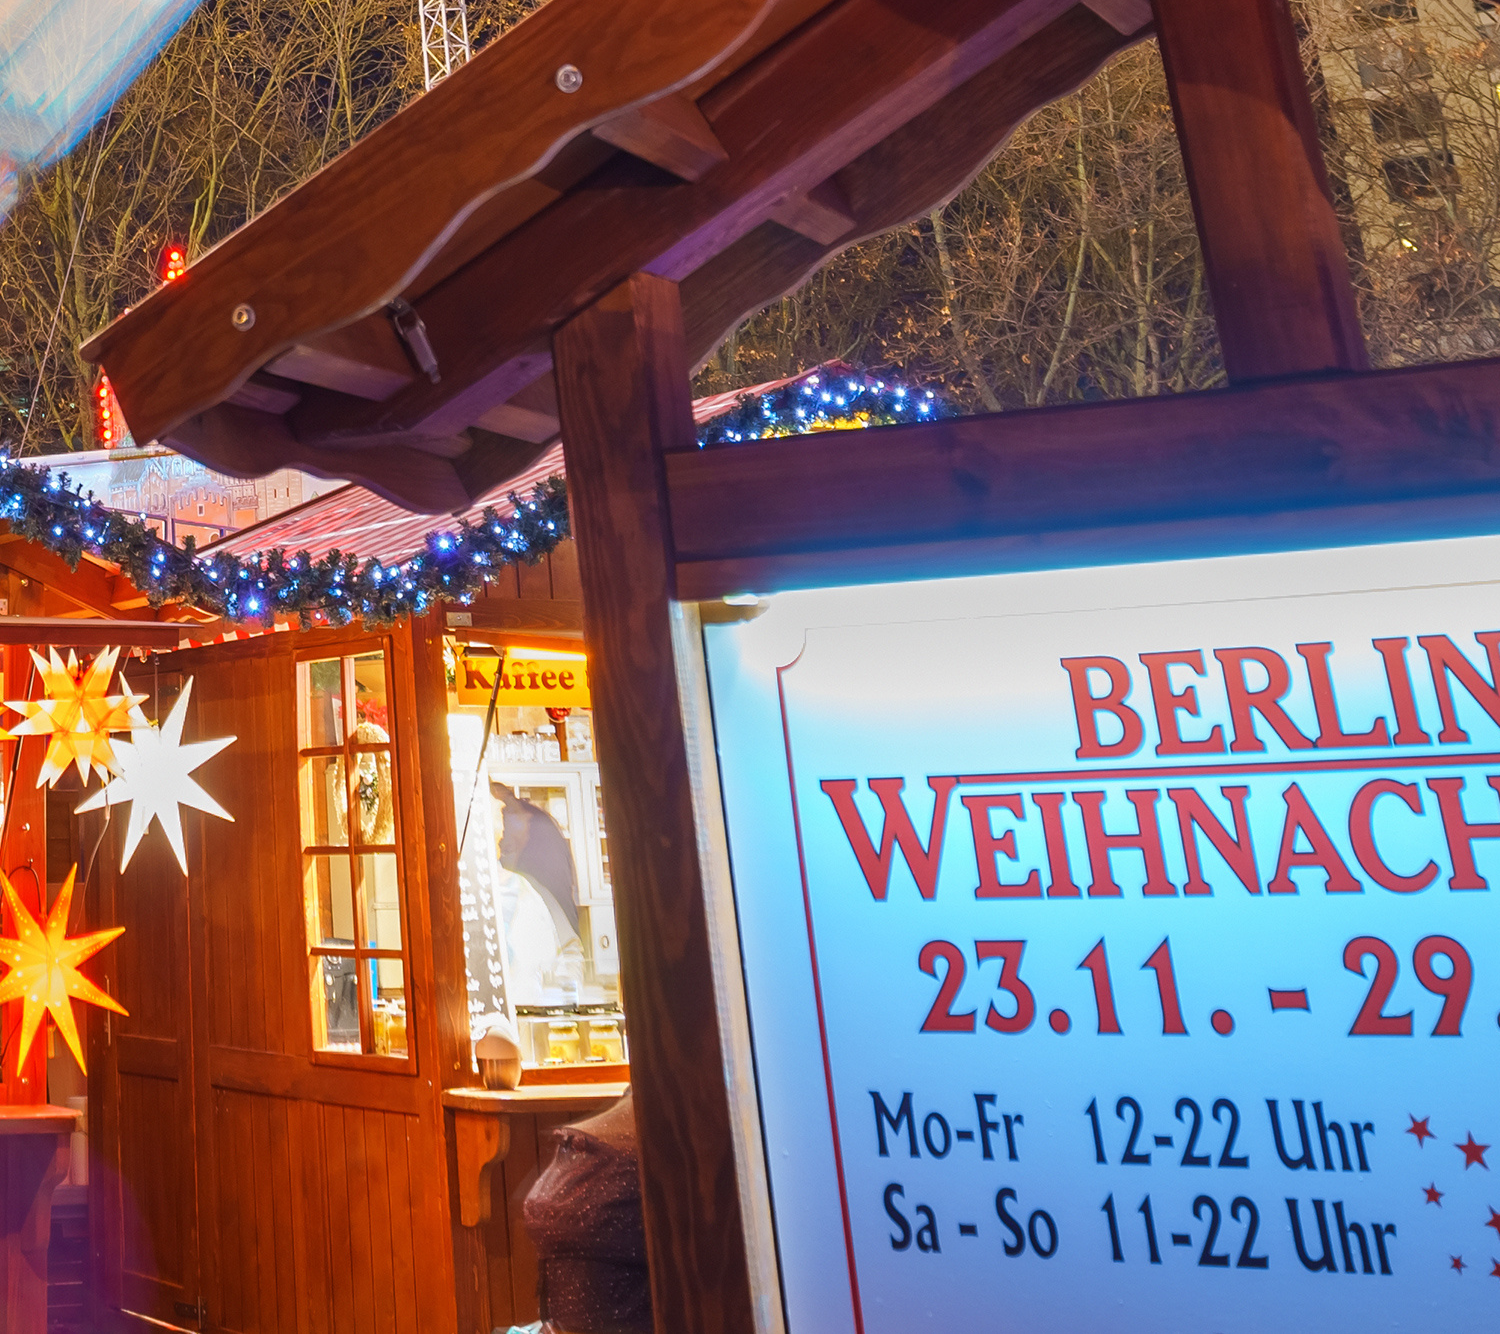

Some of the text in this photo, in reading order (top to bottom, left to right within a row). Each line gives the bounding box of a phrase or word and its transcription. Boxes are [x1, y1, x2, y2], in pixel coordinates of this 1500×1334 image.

[918, 935, 1234, 1035] 23.11.
[1268, 988, 1310, 1011] -
[869, 1091, 1375, 1172] Mo-Fr 12-22 Uhr
[884, 1183, 1397, 1275] Sa - So 11-22 Uhr
